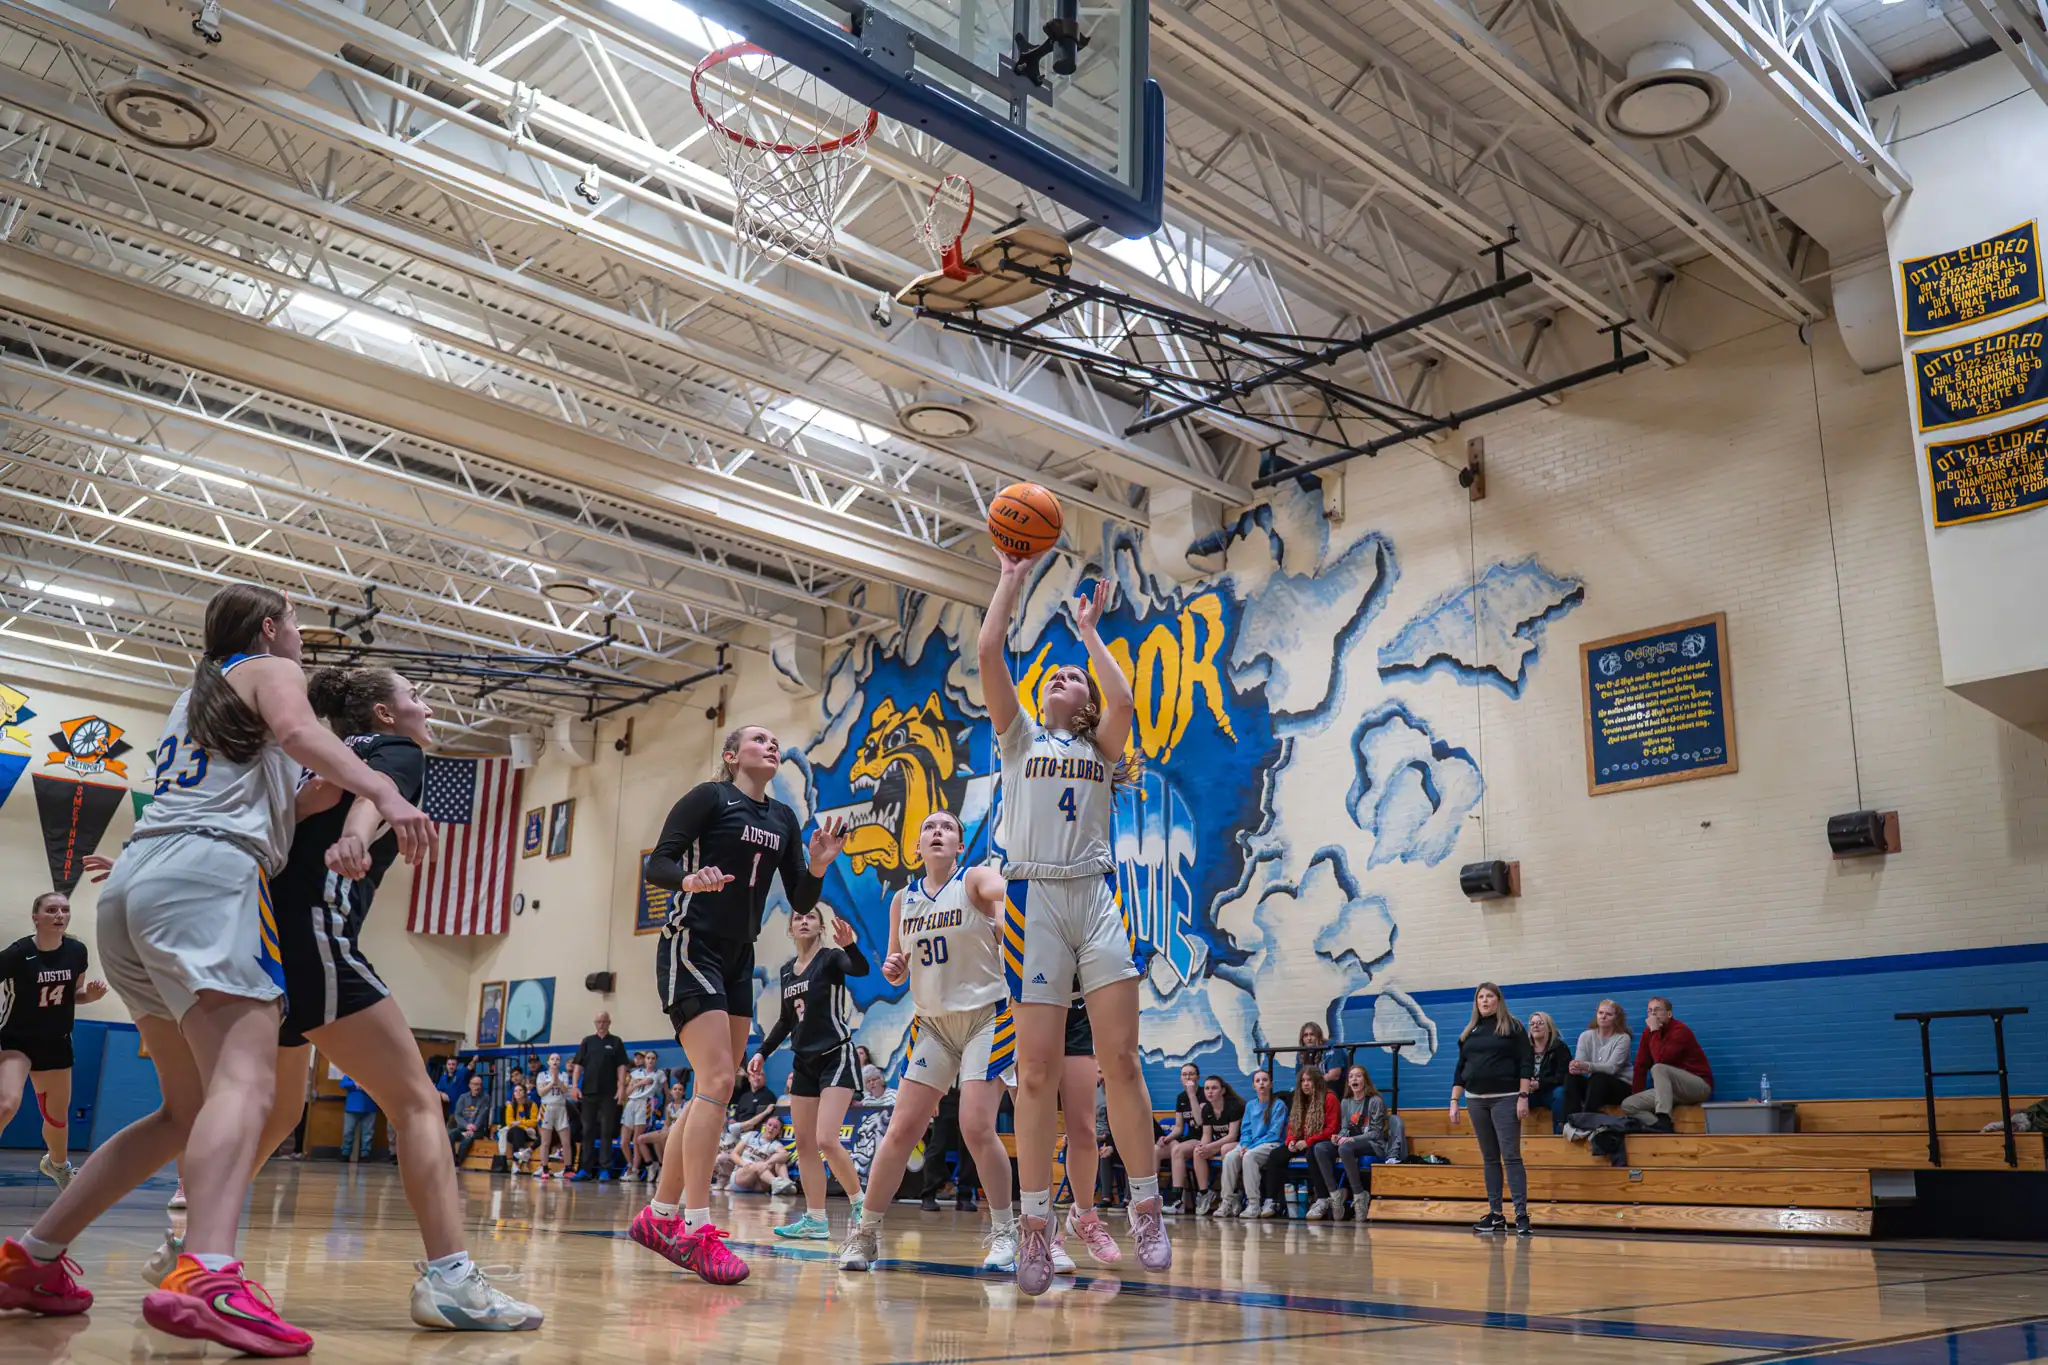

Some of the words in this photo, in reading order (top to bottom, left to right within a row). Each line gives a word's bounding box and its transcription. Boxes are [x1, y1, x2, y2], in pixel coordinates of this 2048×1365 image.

[1909, 238, 2029, 286] OTTO-ELDRED
[1919, 279, 1946, 293] BOYS
[1950, 256, 2022, 286] BASKETBALL
[1941, 255, 1999, 280] 2022-2023
[1918, 292, 1936, 305] NTL
[1940, 271, 2000, 297] CHAMPIONS
[1927, 307, 1951, 320] PIAA
[1954, 296, 1987, 312] FINAL
[1991, 285, 2020, 301] FOUR
[1951, 278, 2011, 303] RUNNER-UP
[1923, 332, 2043, 377] OTTO-ELDRED
[1933, 373, 1962, 387] GIRLS
[1966, 350, 2038, 379] BASKETBALL
[1954, 349, 2014, 373] 2022-2023
[1930, 386, 1952, 397] NTL
[1955, 366, 2015, 391] CHAMPIONS
[1966, 373, 2028, 399] CHAMPIONS
[1951, 398, 1977, 411] PIAA
[1981, 386, 2012, 403] ELITE
[1937, 429, 2048, 471] OTTO-ELDRE
[1946, 467, 1973, 481] BOYS
[1956, 469, 2008, 489] CHAMPIONS
[1981, 471, 2044, 494] CHAMPIONS
[1953, 496, 1981, 508] PIAA
[1985, 489, 2019, 503] FINAL
[2022, 478, 2048, 495] FOUR
[154, 733, 211, 796] 23
[1057, 786, 1077, 822] 4
[63, 785, 84, 881] SMETHPORT
[740, 824, 780, 851] AUSTIN
[749, 851, 762, 888] 1
[916, 935, 949, 967] 30
[37, 969, 72, 983] AUSTIN
[783, 980, 810, 999] AUSTIN
[38, 984, 66, 1008] 14
